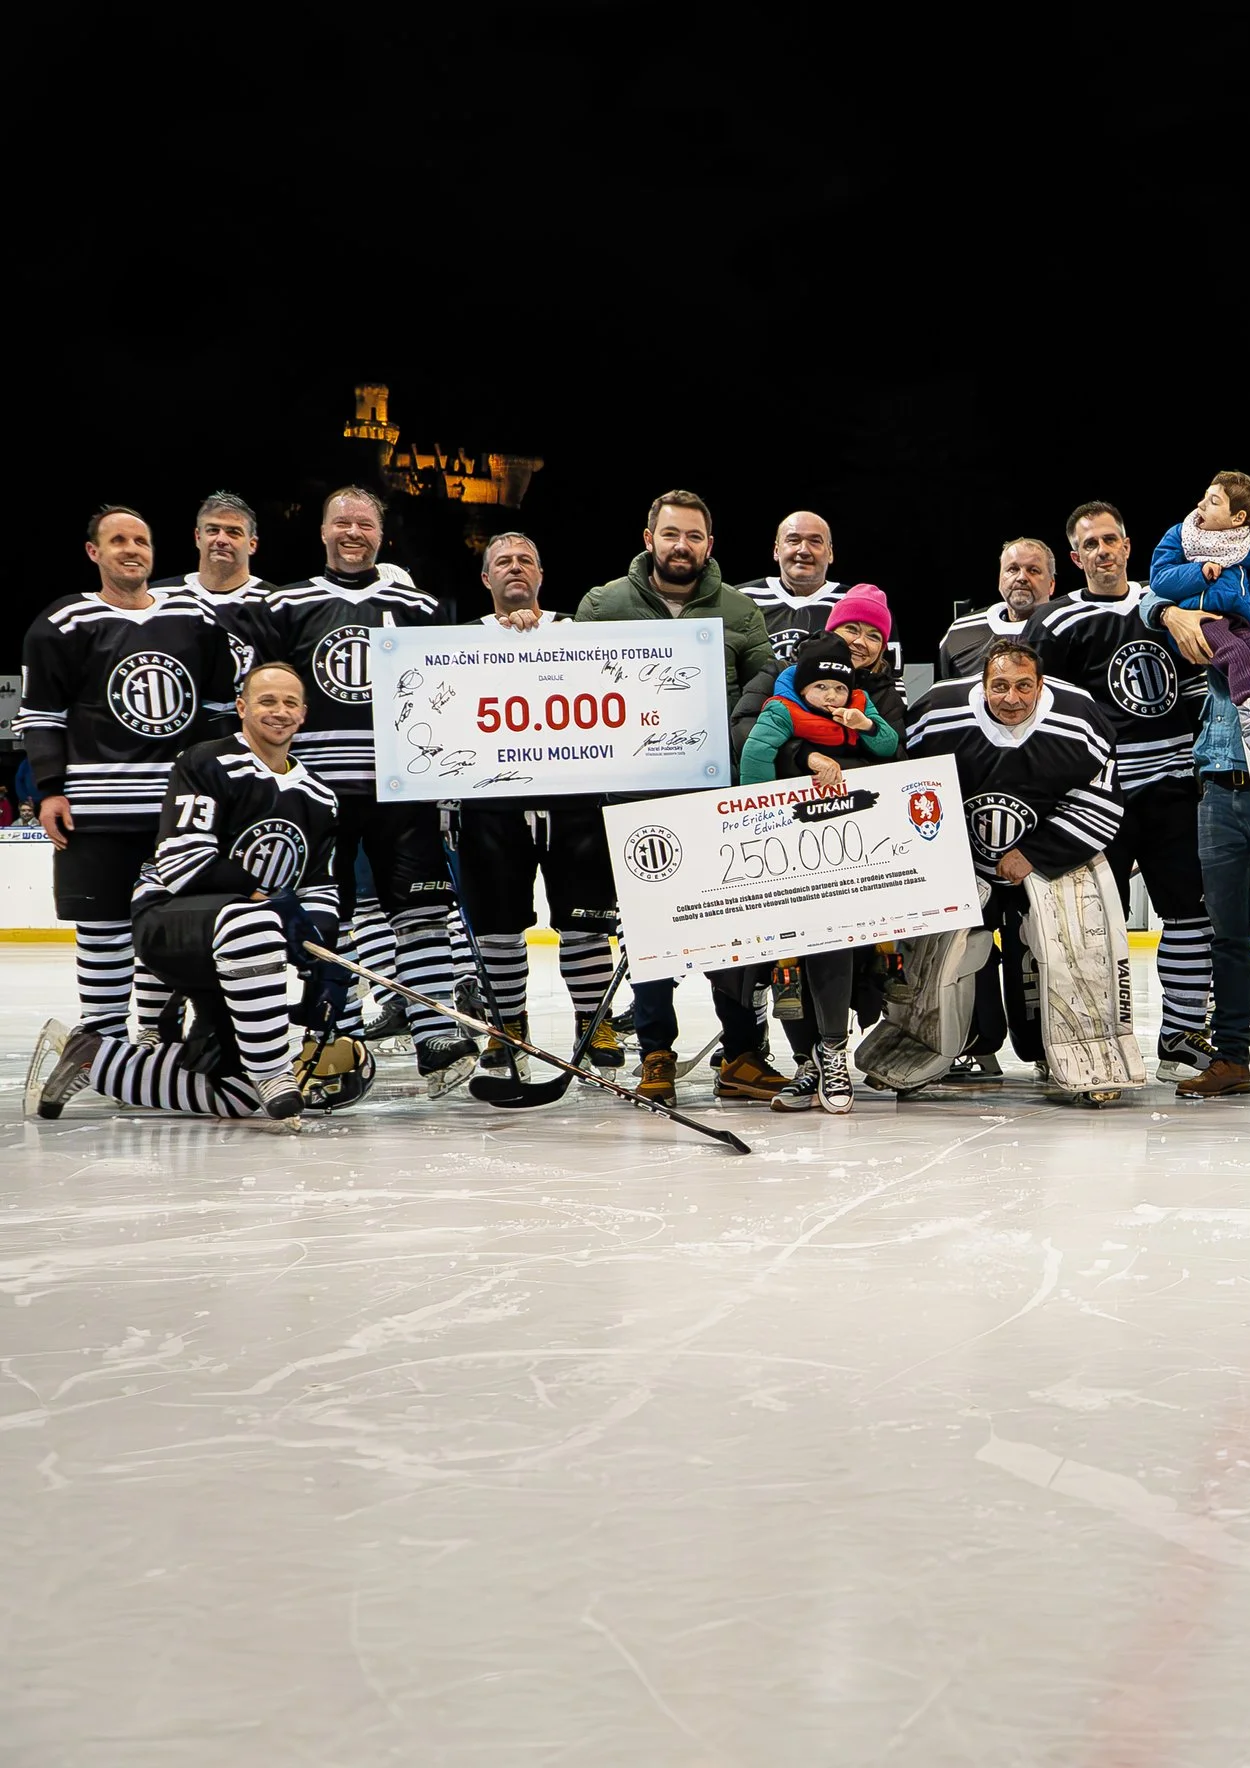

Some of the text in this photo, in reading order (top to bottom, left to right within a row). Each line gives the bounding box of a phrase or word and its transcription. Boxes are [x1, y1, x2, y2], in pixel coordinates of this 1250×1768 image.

[324, 628, 366, 648] DYNA
[425, 647, 673, 666] NADAČNÍ FOND MLÁDEŽNICKÉHO FOTBALU
[1115, 644, 1167, 666] DYNAMO
[119, 655, 184, 677] DYNAMO
[818, 661, 852, 675] CCM
[538, 674, 564, 682] DARUJE
[323, 679, 372, 701] LEGEN
[476, 691, 660, 734] 50.000 Kč
[1122, 691, 1175, 714] LEGENDS
[121, 709, 189, 734] LEGENDS
[497, 744, 614, 763] ERIKU MOLKOVI
[901, 780, 942, 793] CZECHTEAM
[717, 779, 849, 815] CHARITATIVNÍ
[806, 796, 855, 816] UTKÁNÍ
[969, 796, 1030, 816] DYNAMO
[175, 794, 217, 831] 73
[722, 808, 784, 833] Pro Erička a
[630, 827, 673, 845] DYNAMO
[754, 818, 793, 835] Edvinka
[253, 823, 306, 854] DYNAMO
[891, 839, 913, 856] Kč
[633, 861, 678, 880] LEGENDS
[410, 880, 453, 893] BAUE
[725, 897, 738, 906] byla
[764, 891, 773, 899] od
[1116, 957, 1132, 1024] VAUGHN
